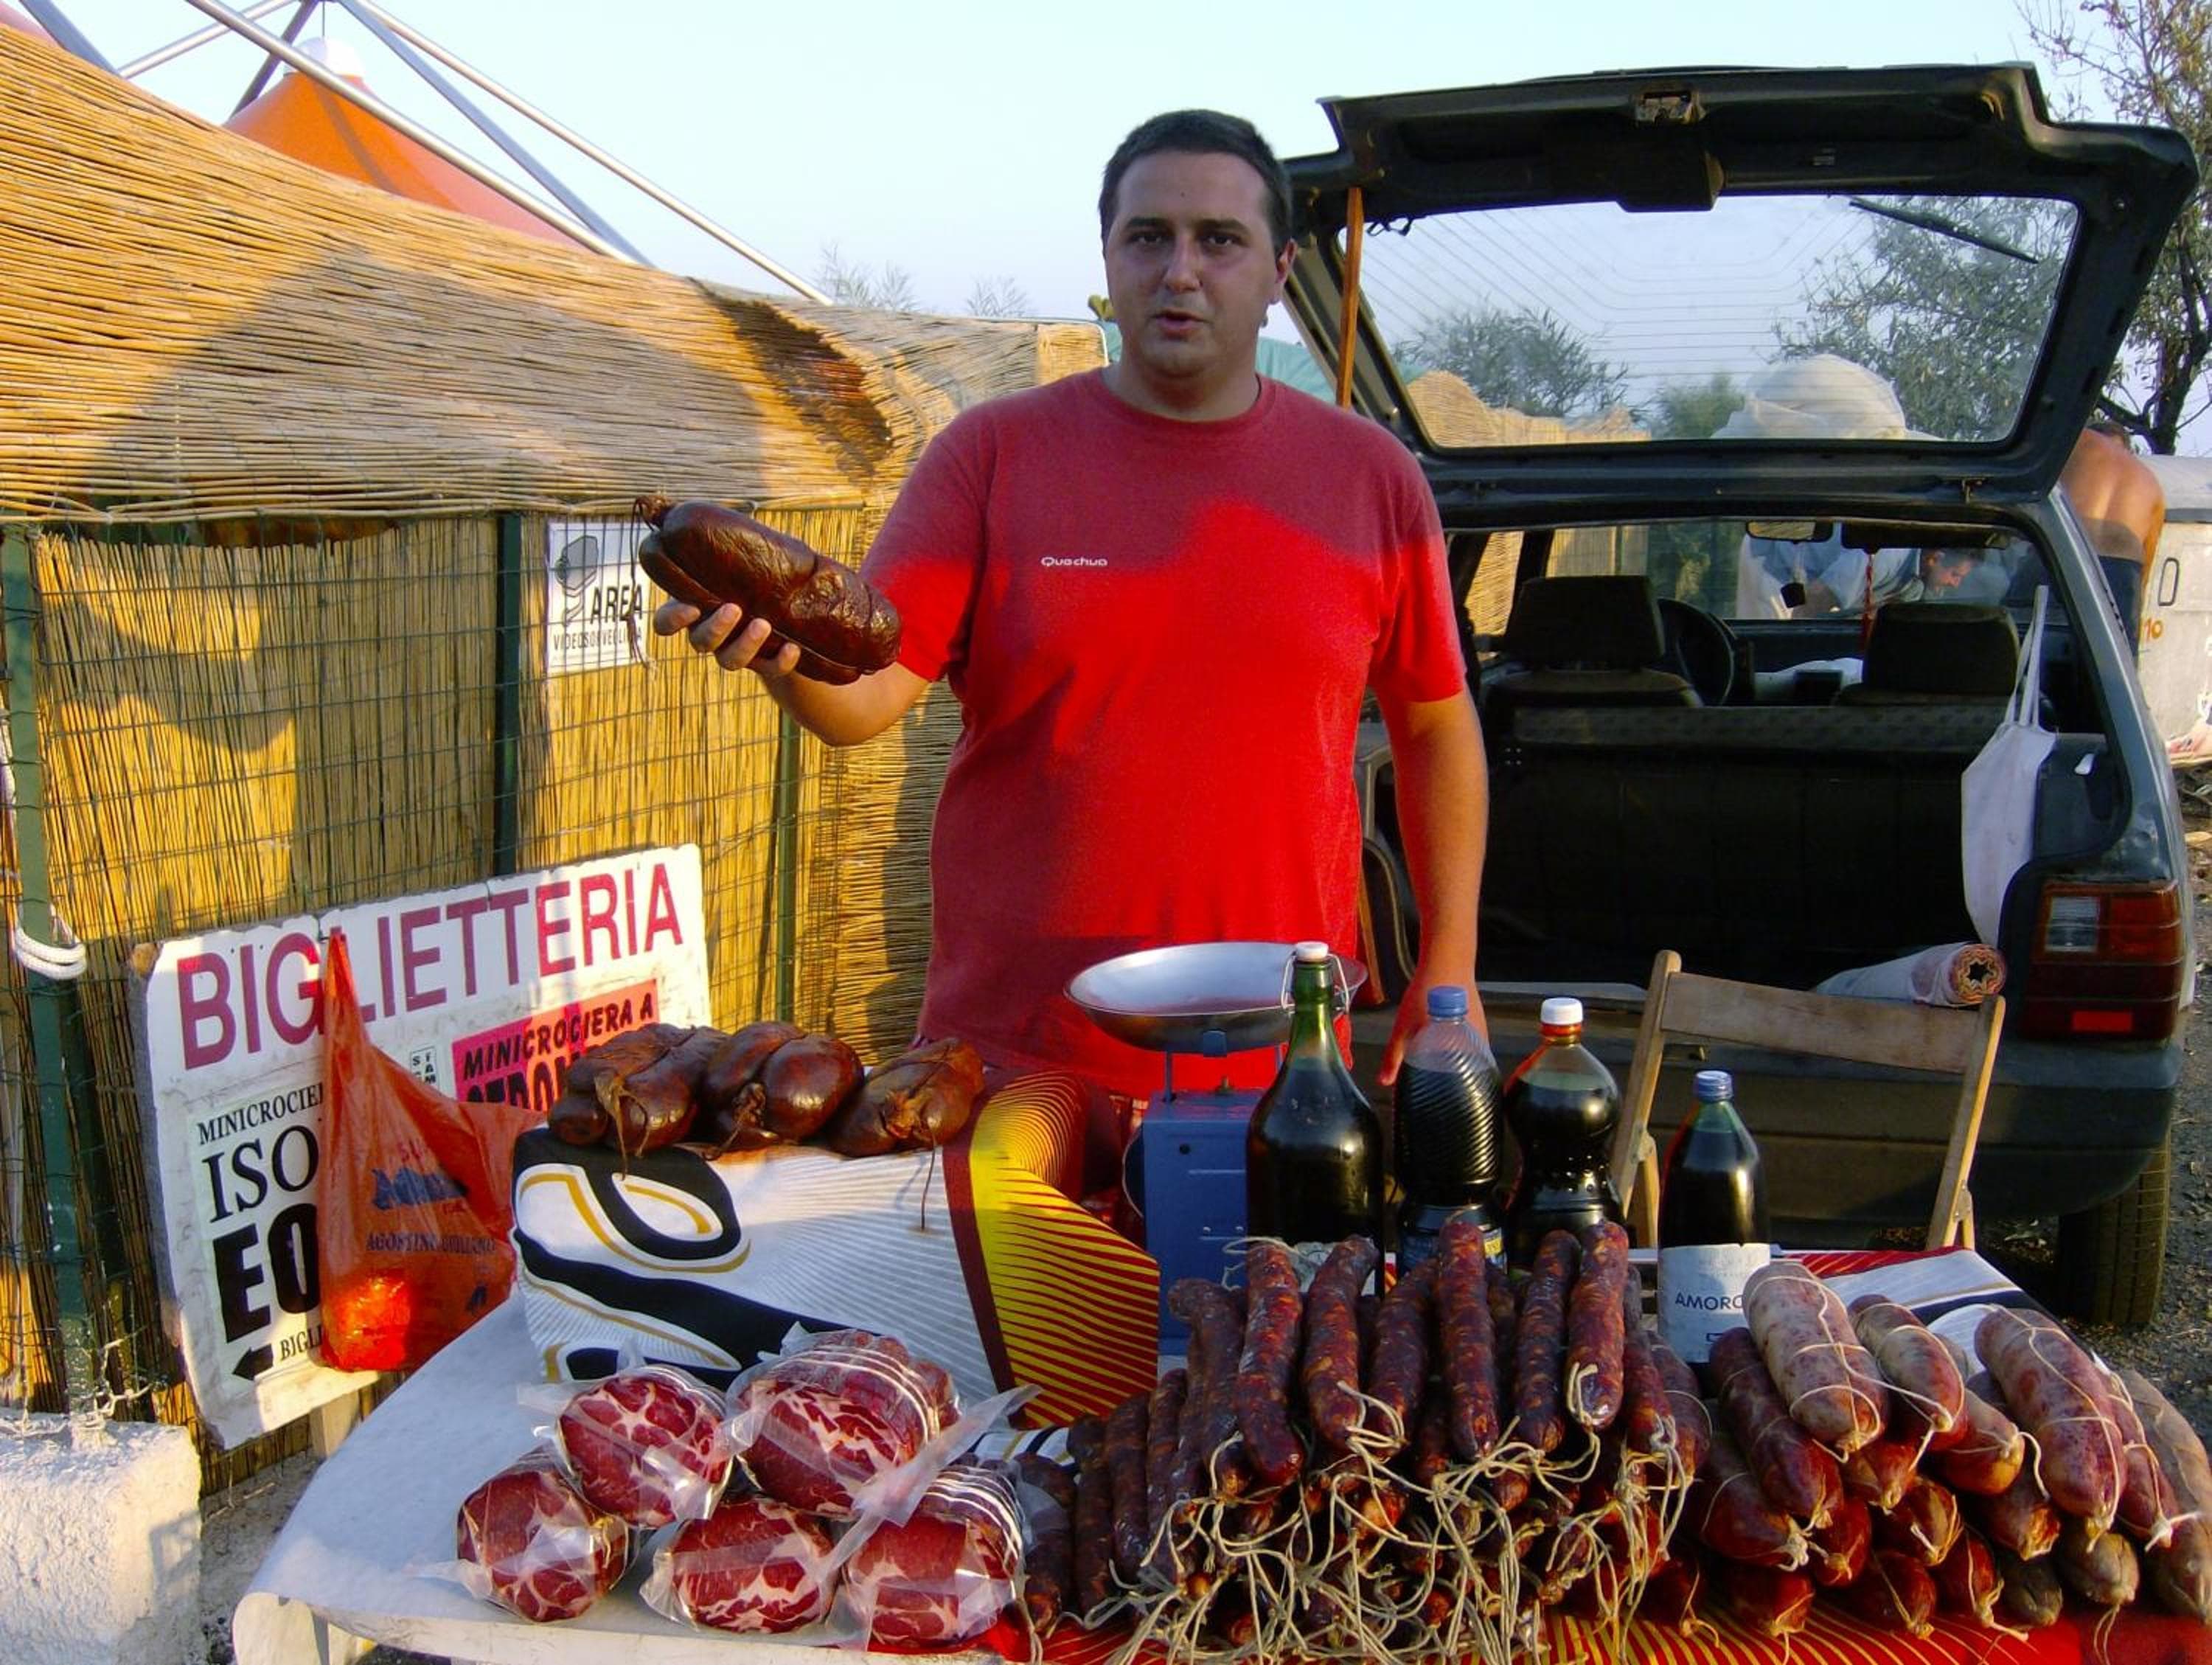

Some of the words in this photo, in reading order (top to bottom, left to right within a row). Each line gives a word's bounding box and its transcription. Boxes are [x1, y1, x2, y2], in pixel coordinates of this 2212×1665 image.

[590, 584, 643, 624] AREA
[462, 998, 633, 1081] MINICROCIERA
[639, 993, 654, 1018] A
